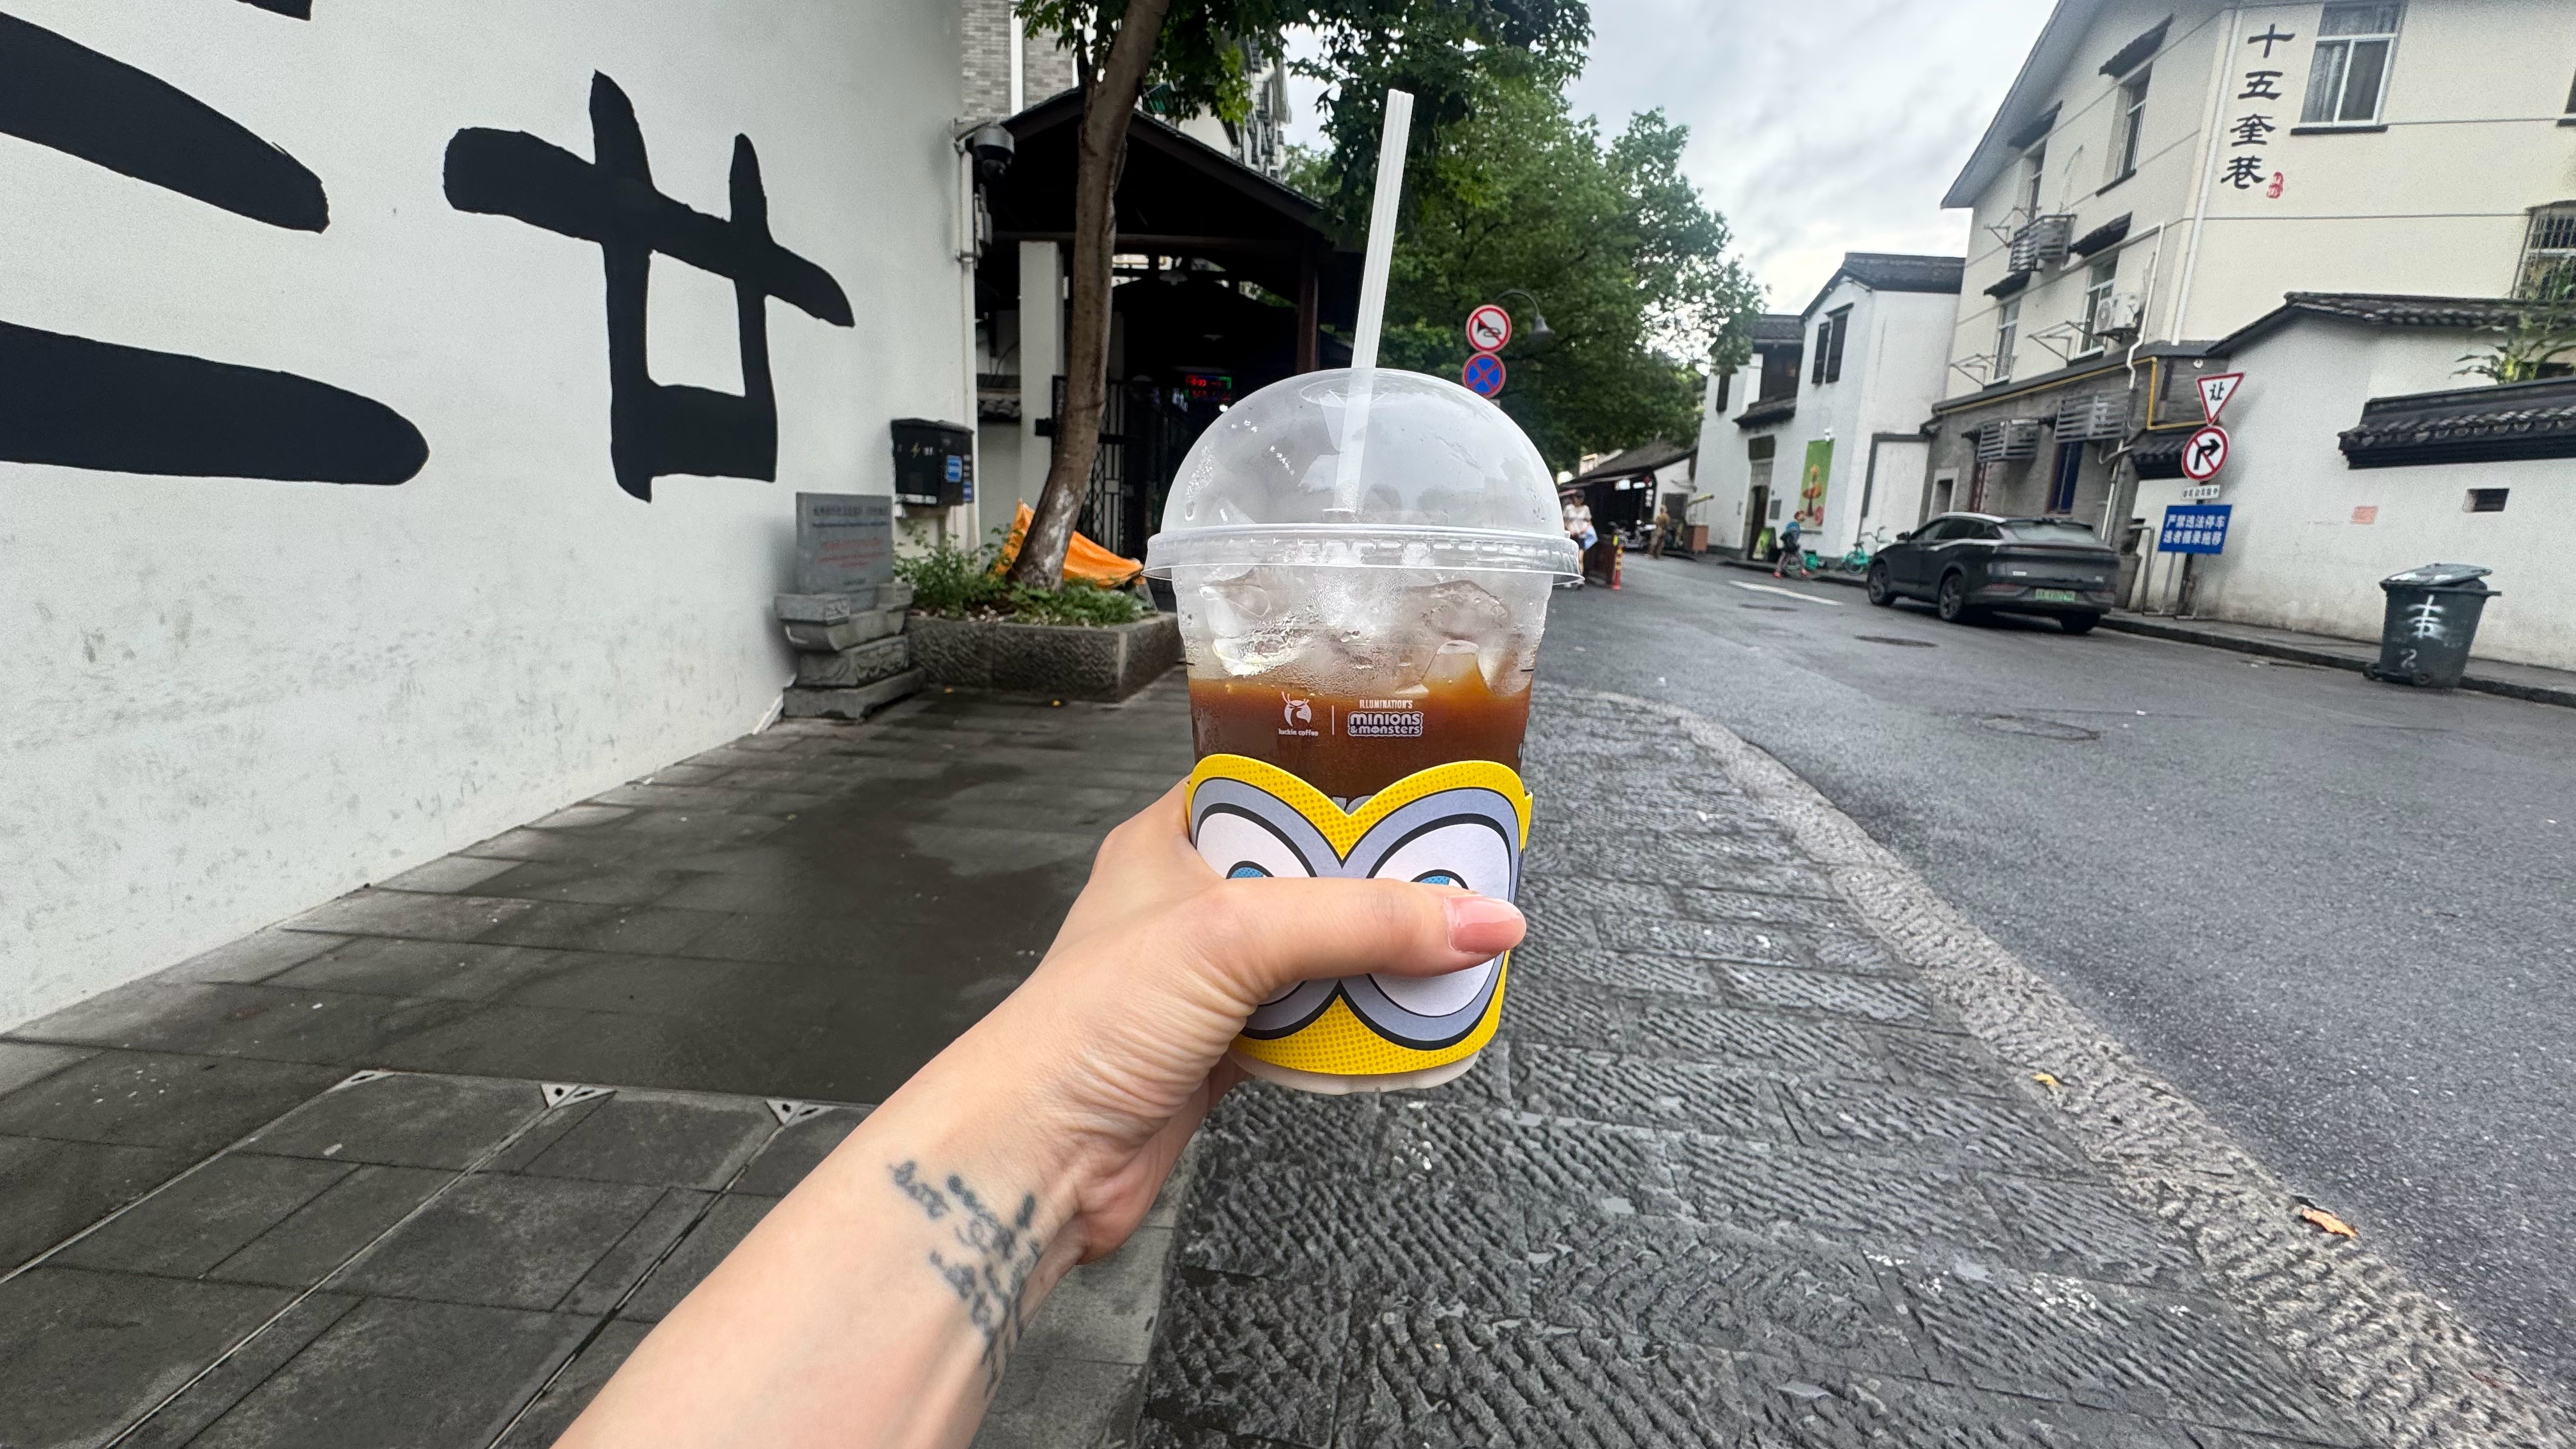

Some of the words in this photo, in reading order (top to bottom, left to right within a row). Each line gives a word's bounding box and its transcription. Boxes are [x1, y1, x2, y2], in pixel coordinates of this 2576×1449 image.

[2220, 23, 2296, 190] 十五奎巷
[2209, 381, 2224, 401] 让
[2166, 514, 2227, 530] 严禁违法停车
